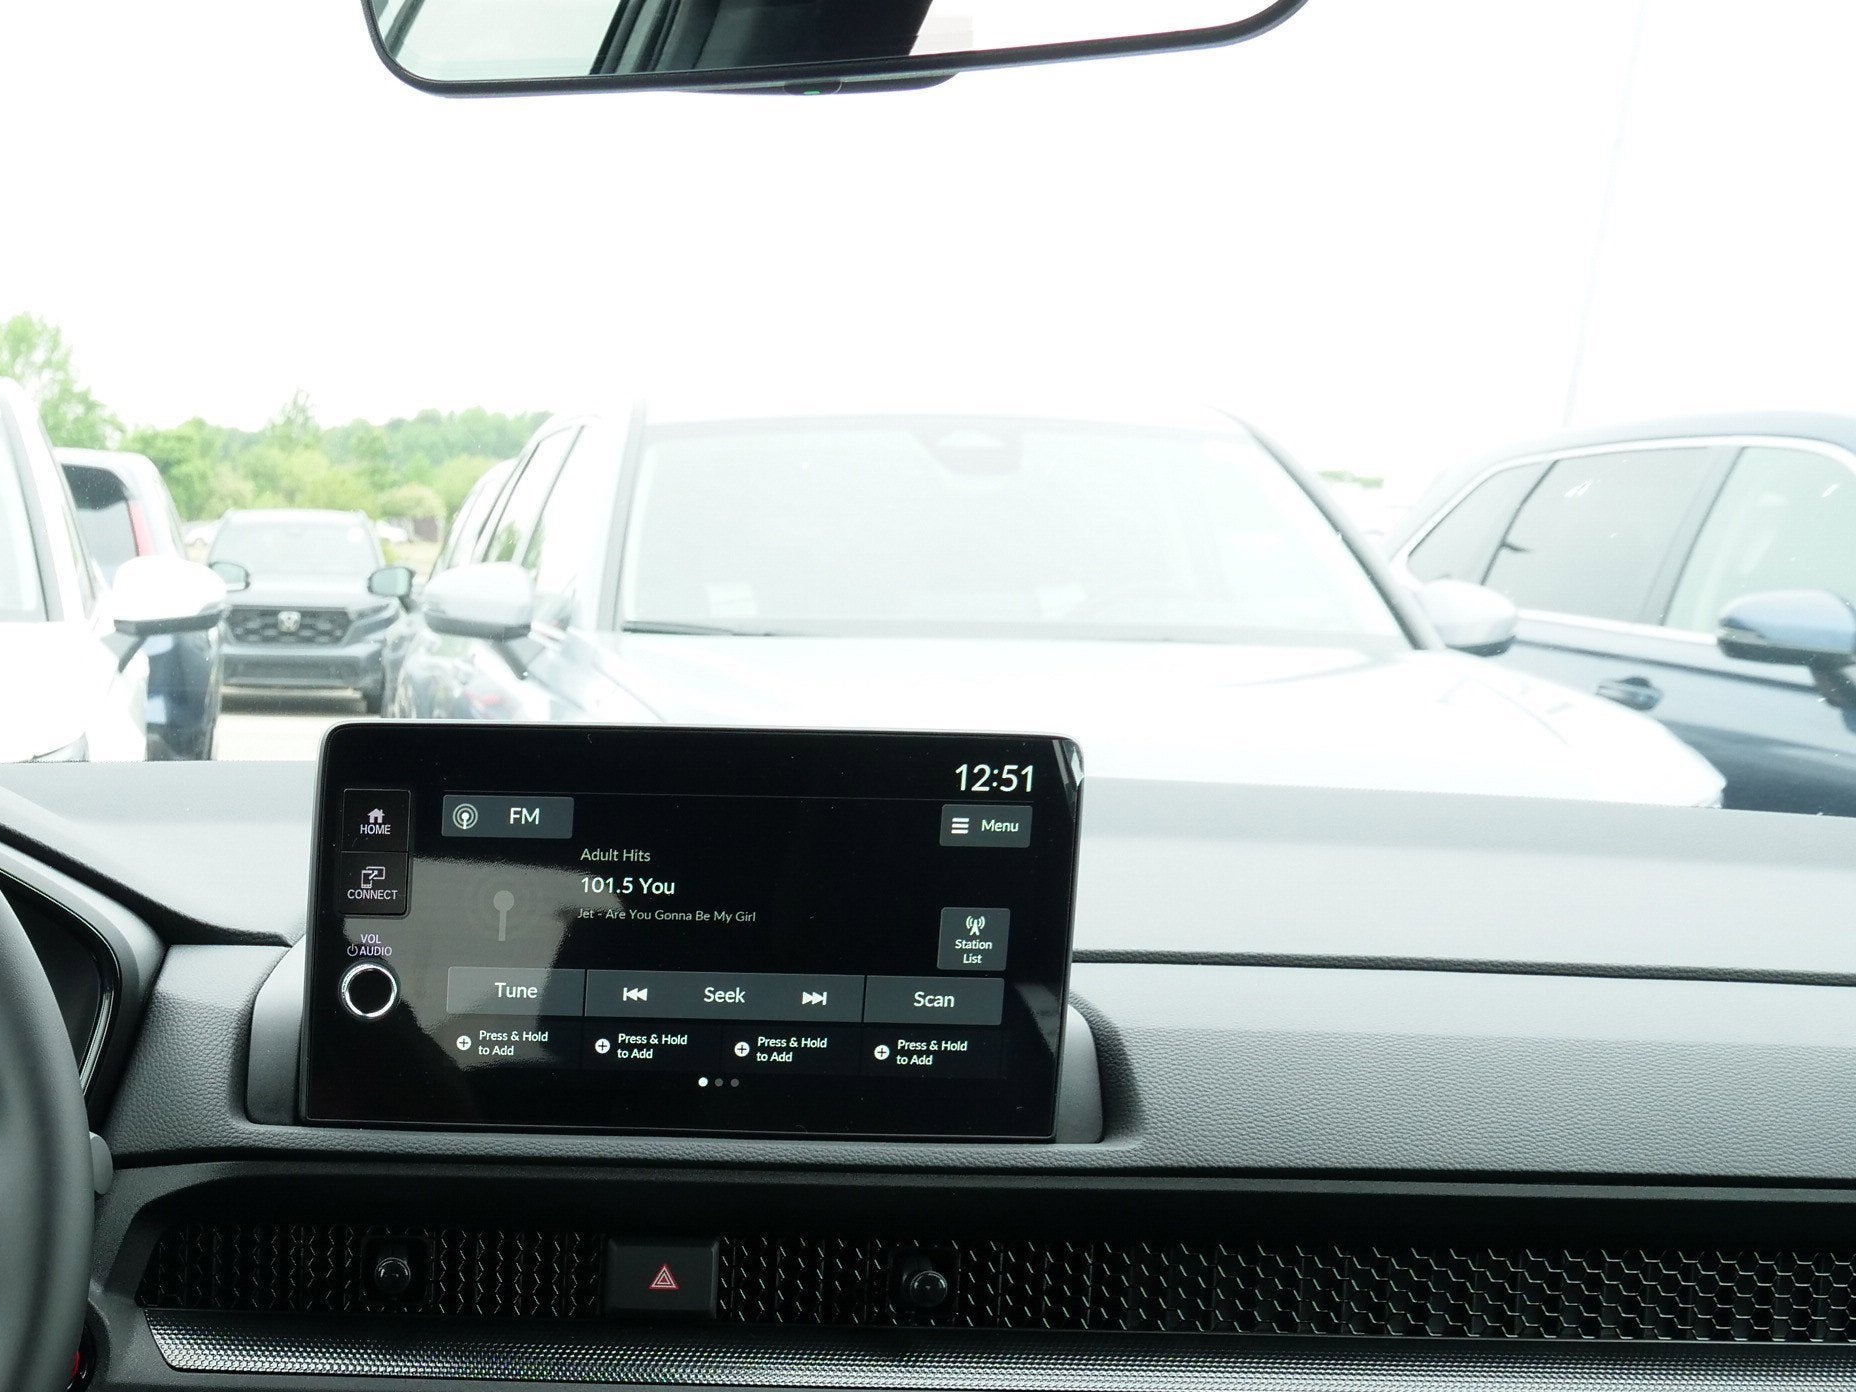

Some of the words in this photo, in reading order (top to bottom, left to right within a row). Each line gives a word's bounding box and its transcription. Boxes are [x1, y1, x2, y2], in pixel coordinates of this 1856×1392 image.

[955, 763, 1036, 792] 12:51
[508, 807, 541, 825] FM
[359, 823, 392, 836] HOME
[980, 819, 1020, 832] Menu
[579, 848, 619, 863] Adult
[622, 848, 652, 863] Hits
[580, 876, 634, 894] 101.5
[640, 877, 676, 895] You
[347, 889, 398, 901] CONNECT
[576, 908, 595, 921] Jet
[605, 909, 627, 920] Are
[629, 909, 652, 921] You
[654, 910, 693, 922] Gonna
[695, 910, 711, 922] Be
[713, 910, 733, 924] My
[735, 911, 757, 922] Girl
[360, 933, 381, 944] VOL
[954, 938, 993, 951] Station
[359, 946, 392, 957] AUDIO
[962, 953, 983, 965] List
[493, 982, 538, 999] Tune
[703, 986, 746, 1003] Seek
[913, 991, 956, 1008] Scan
[478, 1030, 508, 1043] Press
[511, 1030, 520, 1043] &
[522, 1030, 549, 1043] Hold
[617, 1033, 648, 1046] Press
[650, 1034, 659, 1046] &
[661, 1034, 688, 1047] Hold
[757, 1036, 787, 1049] Press
[789, 1037, 798, 1049] &
[800, 1037, 828, 1049] Hold
[477, 1046, 489, 1056] to
[491, 1045, 515, 1057] Add
[897, 1039, 927, 1052] Press
[929, 1040, 938, 1053] &
[941, 1040, 968, 1053] Hold
[617, 1049, 629, 1060] to
[631, 1049, 654, 1060] Add
[756, 1052, 768, 1063] to
[770, 1051, 793, 1063] Add
[896, 1055, 909, 1066] to
[911, 1054, 934, 1066] Add
